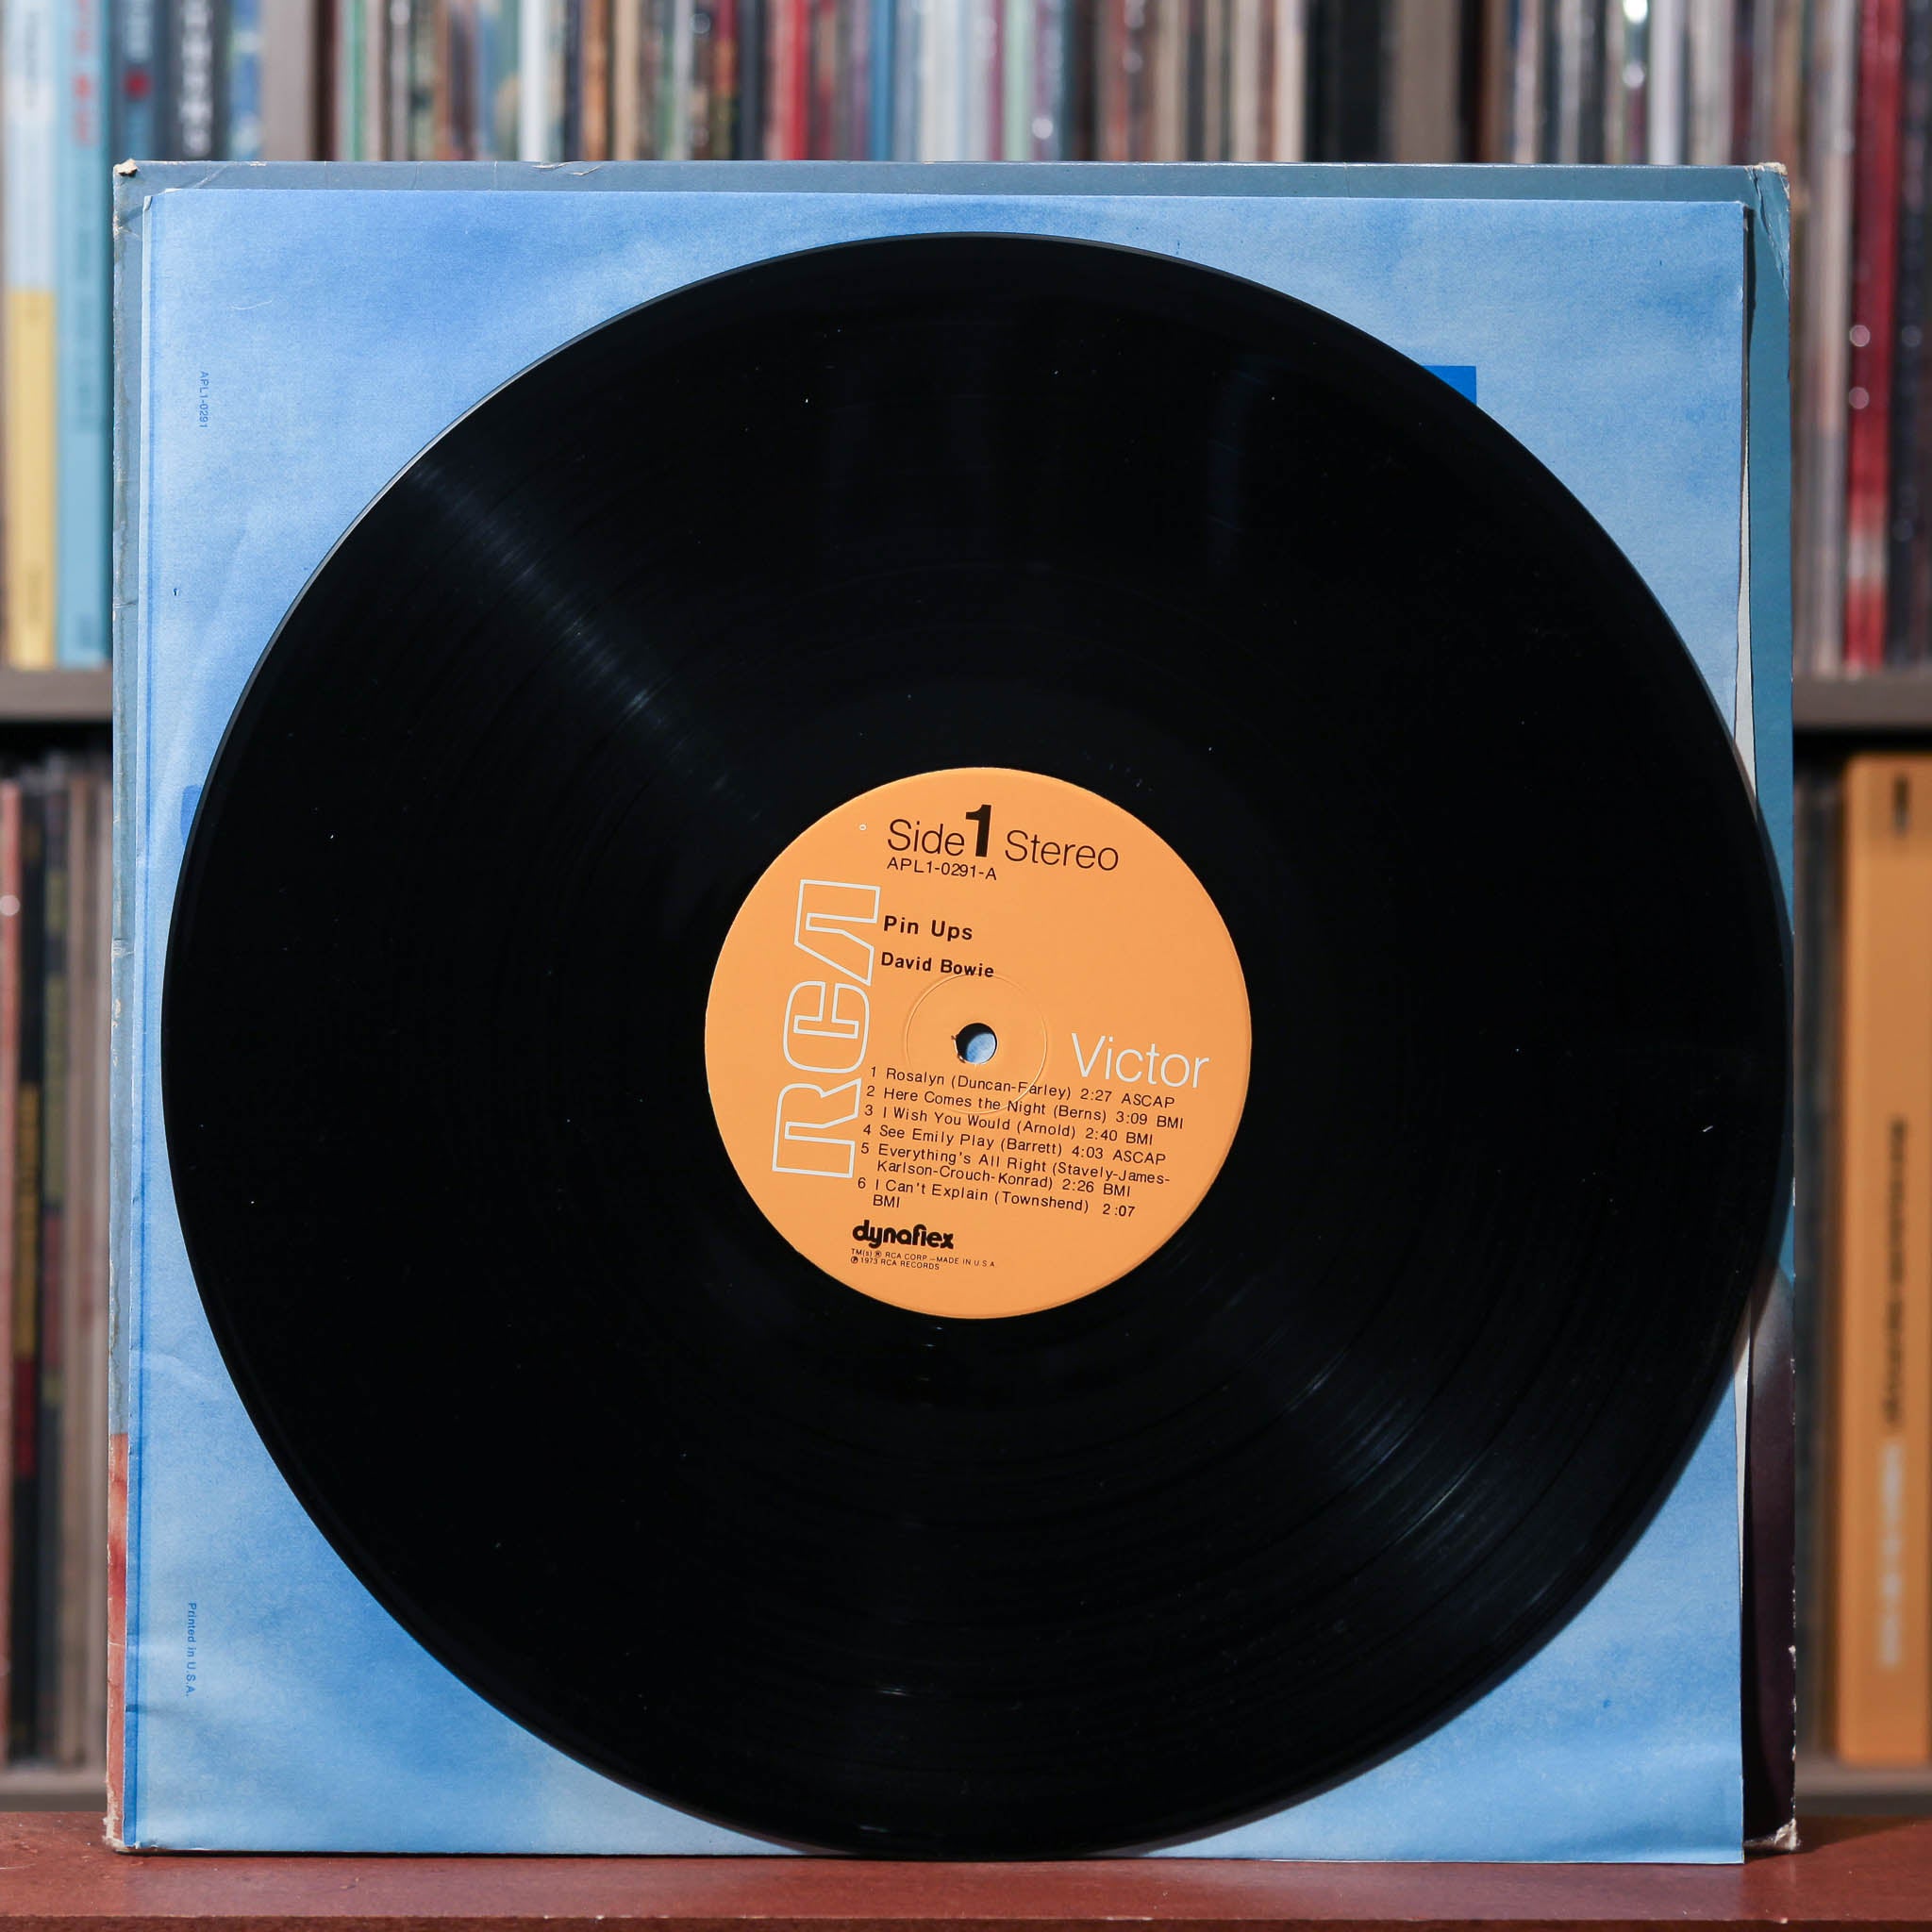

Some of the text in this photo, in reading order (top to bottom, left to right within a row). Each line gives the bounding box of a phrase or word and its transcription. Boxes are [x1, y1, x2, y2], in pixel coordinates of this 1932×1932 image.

[199, 371, 209, 427] APL1-0291
[887, 804, 1120, 872] Side 1 Stereo
[886, 857, 997, 881] APL1-0291-A
[883, 915, 974, 941] Pin Ups
[880, 951, 994, 978] David Bowie
[772, 879, 881, 1179] RCA
[1071, 1032, 1210, 1090] Victor
[871, 1066, 1175, 1108] 1 Rosalyn (Duncan-Farley) 2:27 ASCAP
[864, 1104, 1153, 1146] 3 I Wish You Would (Arnold) 2:40 BMI
[866, 1085, 1184, 1129] 2 Here Comes the Night (Berns) 3:09 BMI
[860, 1142, 1171, 1185] 5 Everything's All Right (Stavely-James-
[863, 1124, 1166, 1166] 4 See Emily Play (Barrett) 4:03 ASCAP
[858, 1177, 866, 1189] 6
[875, 1179, 879, 1191] I
[885, 1179, 926, 1194] Can't
[931, 1184, 989, 1200] Explain
[994, 1191, 1090, 1213] (Townshend)
[876, 1159, 1131, 1198] Karlson-Crouch-Konrad) 2:26 BMI
[873, 1194, 901, 1208] BMI
[852, 1219, 954, 1249] dynaflex
[860, 1256, 878, 1265] 1973
[900, 1260, 940, 1271] RECORDS
[885, 1251, 902, 1259] RCA
[187, 1602, 197, 1642] Printed
[187, 1647, 197, 1657] in
